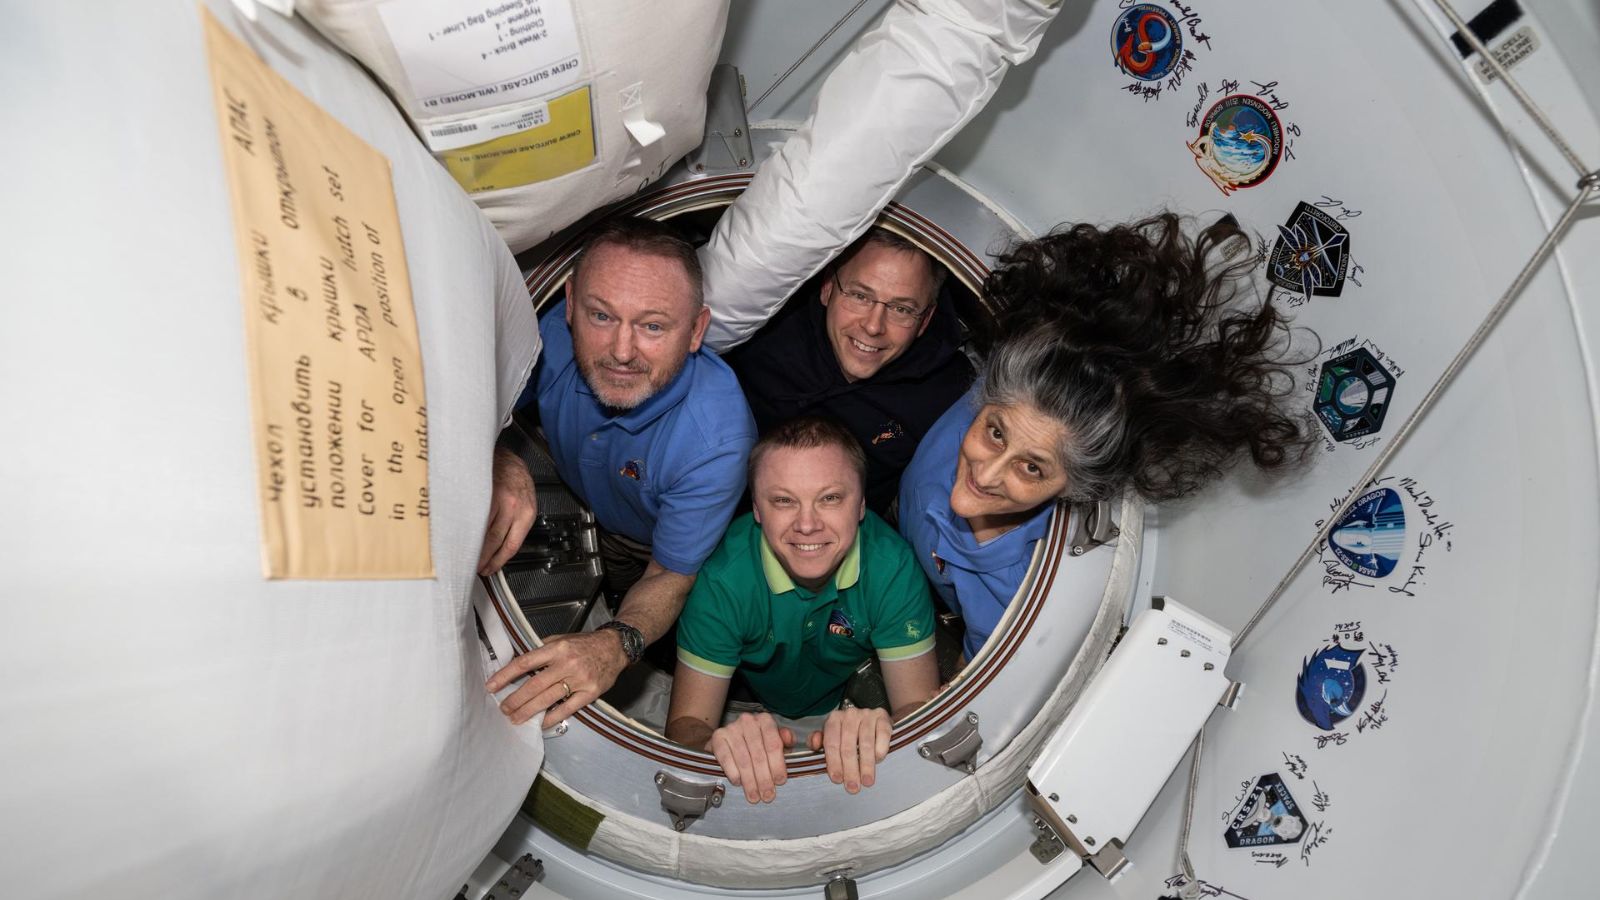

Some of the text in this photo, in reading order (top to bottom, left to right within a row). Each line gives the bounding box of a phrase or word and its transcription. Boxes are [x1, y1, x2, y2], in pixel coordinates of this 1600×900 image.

[486, 0, 523, 18] Sleeping
[508, 6, 541, 24] Hygiene
[443, 21, 466, 35] Liner
[467, 14, 485, 26] Bag
[510, 18, 545, 36] Clothing
[428, 33, 435, 41] 1
[518, 29, 548, 46] 2-Week
[1503, 33, 1525, 50] CELL
[1511, 36, 1530, 53] LINE
[494, 42, 517, 55] Brick
[424, 58, 579, 108] CREW SUITCASE (WILMORE) B1
[1242, 98, 1272, 120] MOGENSEN
[223, 86, 255, 156] АПАС
[559, 129, 581, 141] CREW
[519, 138, 558, 152] SUITCASE
[286, 285, 309, 302] в
[322, 165, 376, 516] Cover for APDA hatch set
[362, 221, 409, 520] in the open position of
[319, 256, 346, 509] положении крышки
[290, 354, 323, 509] установить
[266, 423, 285, 502] Чехол
[415, 405, 430, 519] the hatch
[1357, 489, 1387, 507] DRAGON
[1335, 547, 1377, 577] NASA CRS-22
[1274, 782, 1296, 810] SPACEX
[1240, 836, 1275, 845] DRAGON
